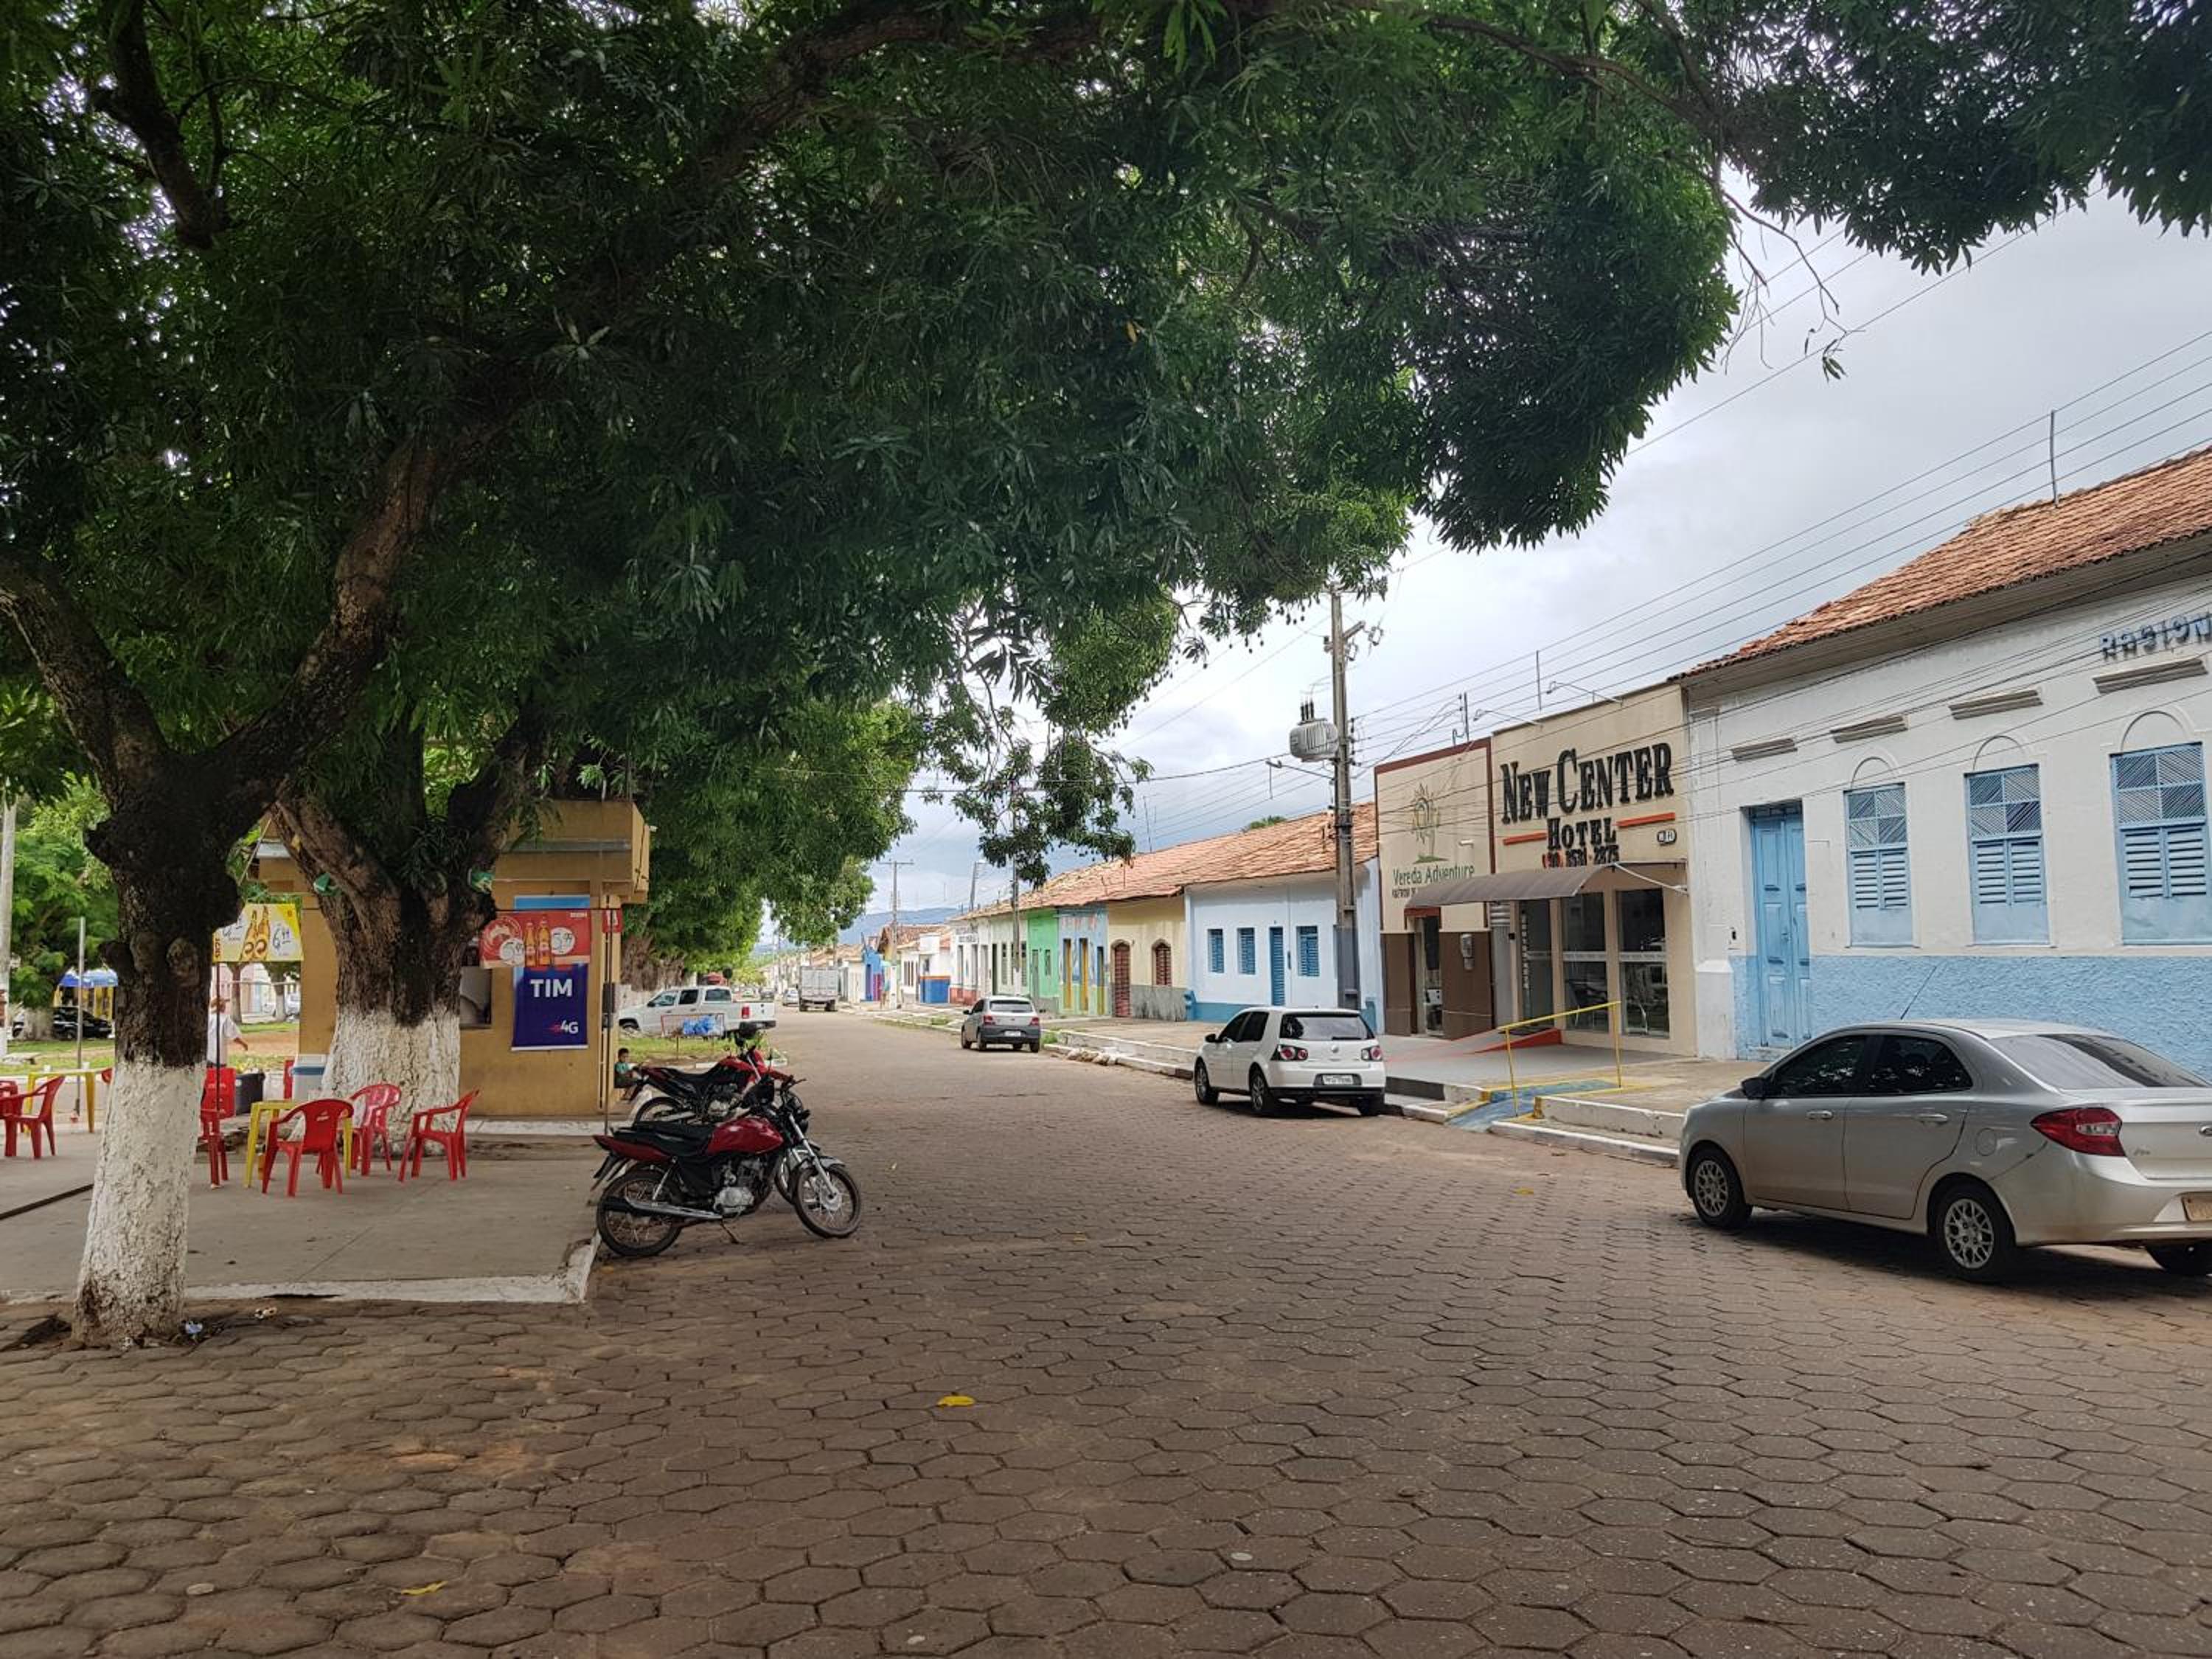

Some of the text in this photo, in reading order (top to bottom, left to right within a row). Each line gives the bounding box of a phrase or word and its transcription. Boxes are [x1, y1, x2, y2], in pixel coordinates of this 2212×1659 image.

[1500, 742, 1674, 825] NEW CENTER
[1547, 817, 1616, 850] HOTEL
[1393, 864, 1475, 886] Vereda Adventure
[529, 978, 573, 998] TIM
[560, 1020, 579, 1034] 4G
